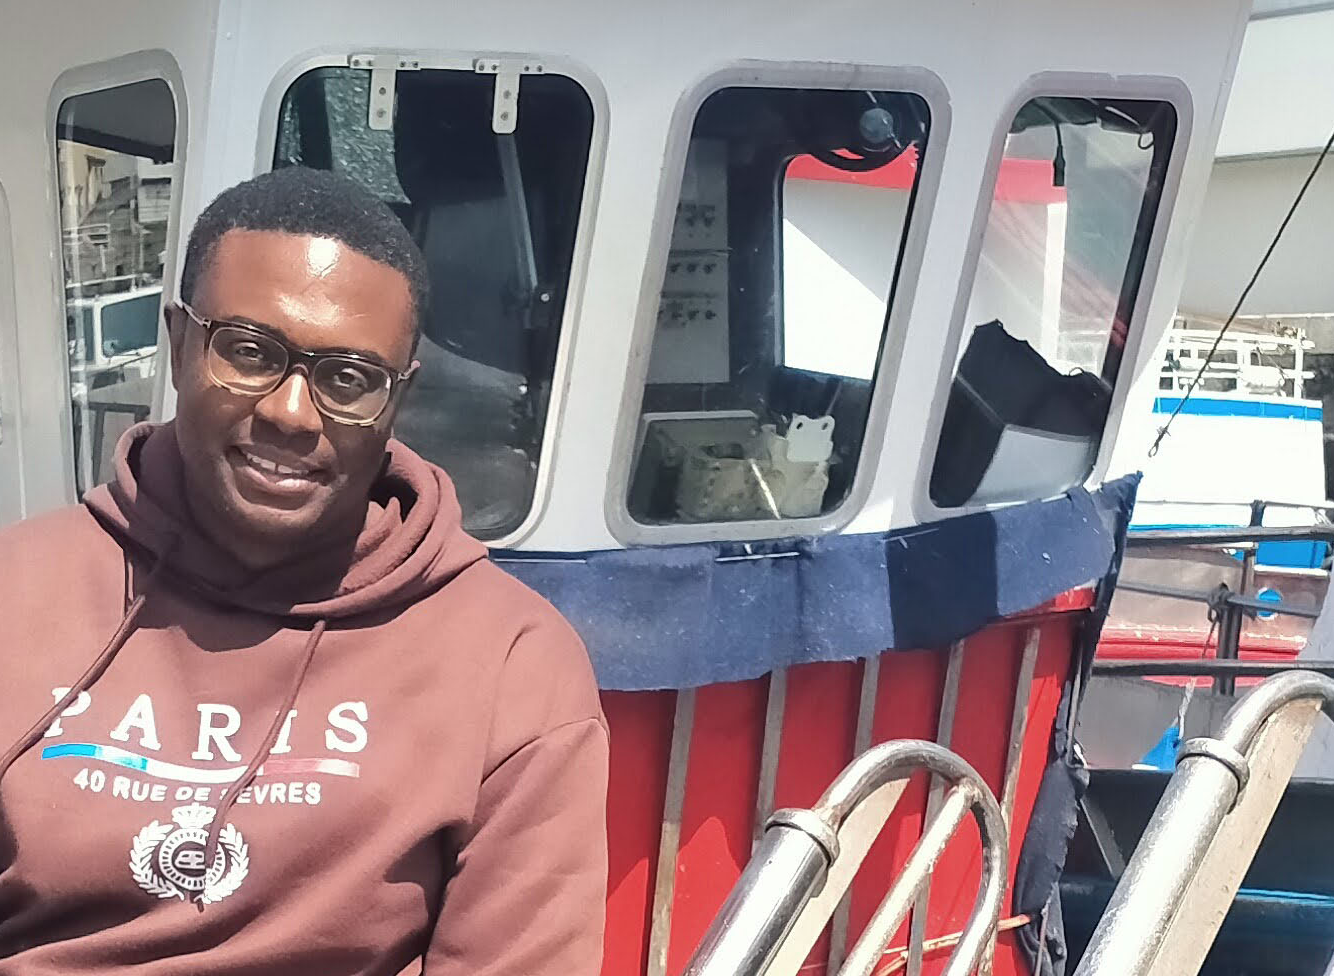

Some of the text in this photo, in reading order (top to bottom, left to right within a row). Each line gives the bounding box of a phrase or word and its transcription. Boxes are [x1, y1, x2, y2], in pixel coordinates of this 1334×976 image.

[43, 687, 368, 762] PARIS
[73, 767, 106, 793] 40
[112, 774, 167, 802] RUE
[174, 785, 212, 802] DE
